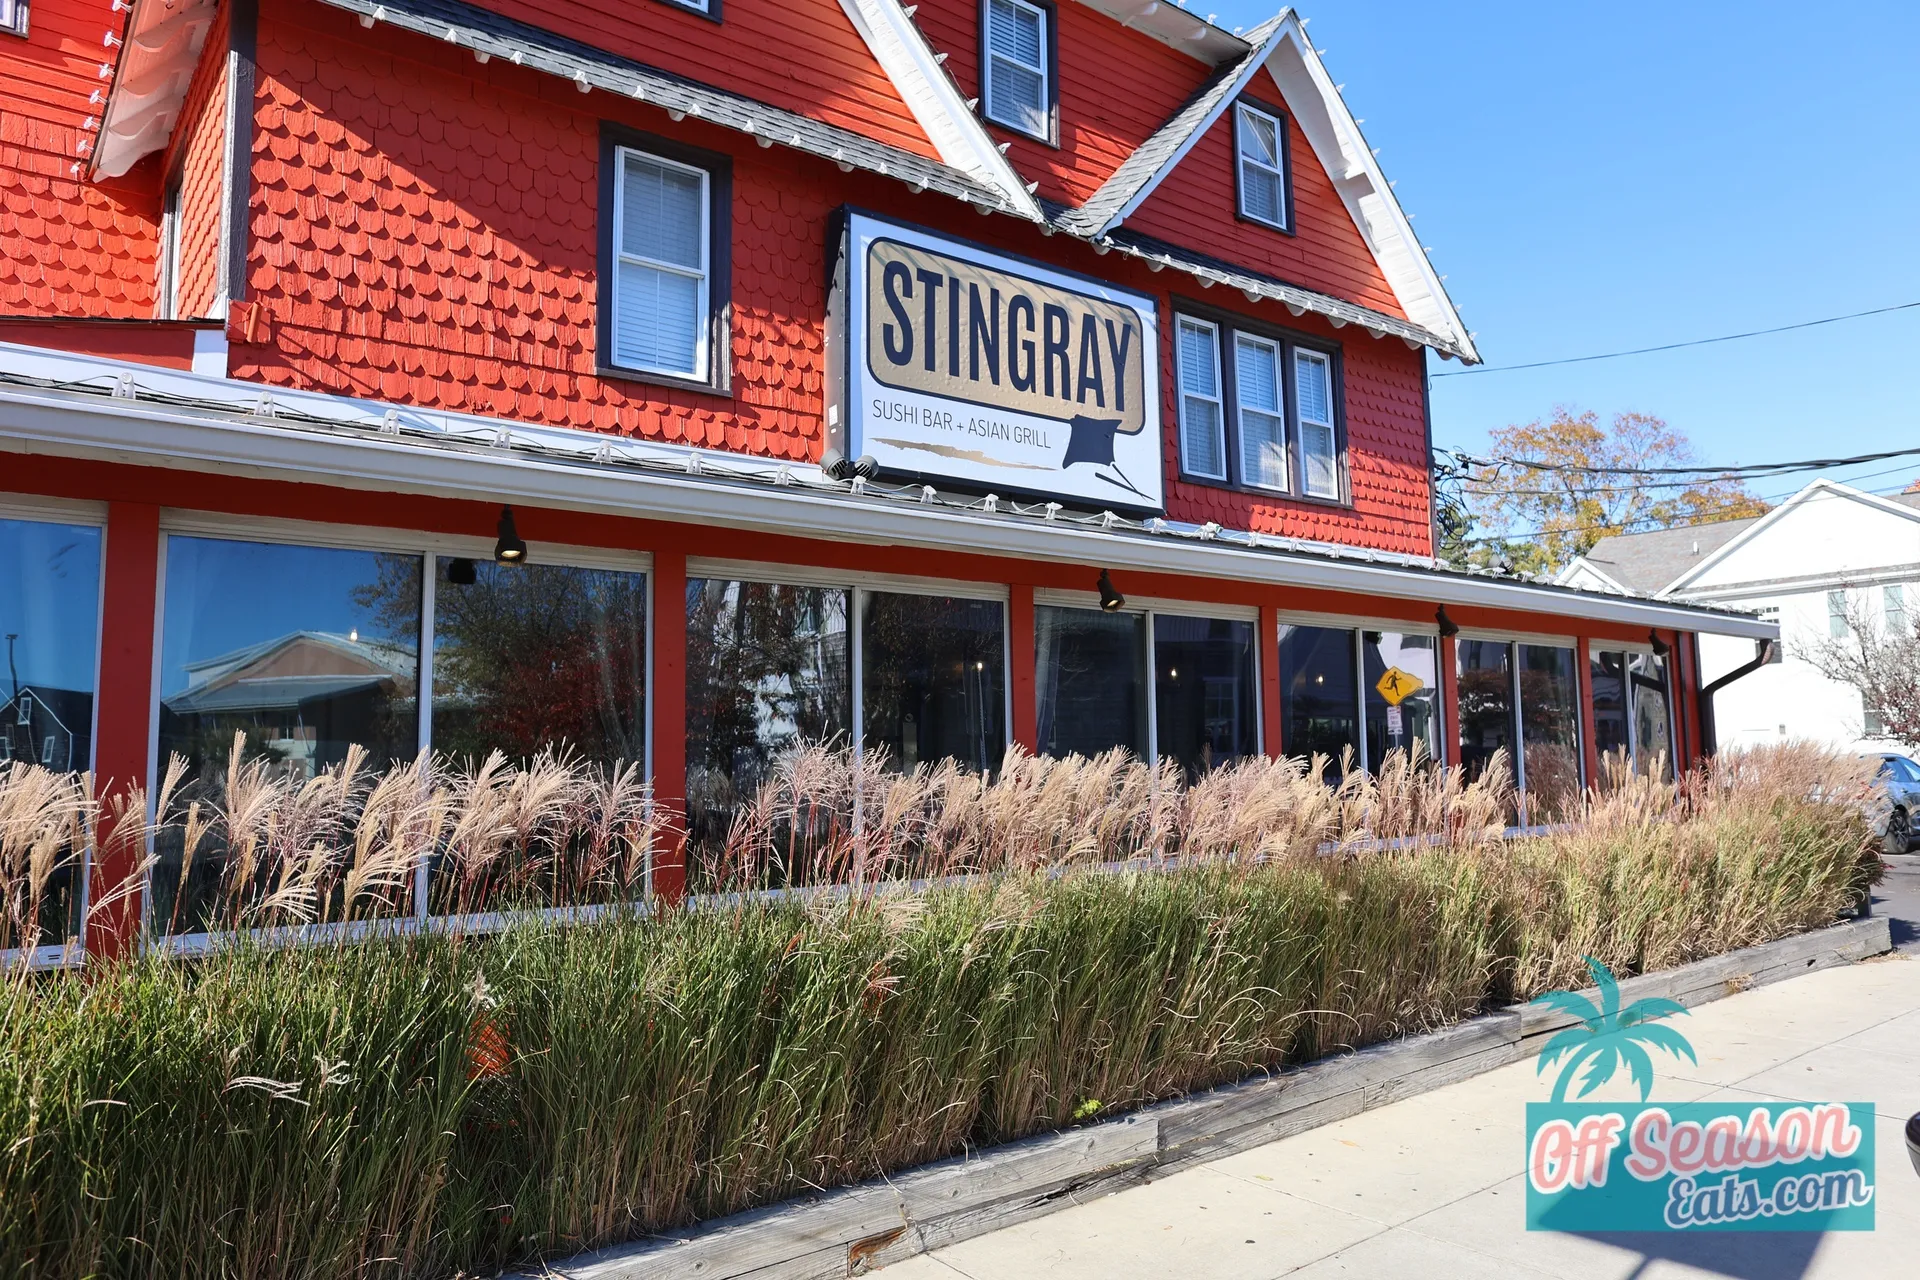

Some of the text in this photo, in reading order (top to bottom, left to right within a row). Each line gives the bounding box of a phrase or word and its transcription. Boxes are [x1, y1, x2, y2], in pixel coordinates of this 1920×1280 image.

[882, 260, 1132, 412] STINGRAY
[872, 399, 1052, 449] SUSHI BAR + ASIAN GRILL
